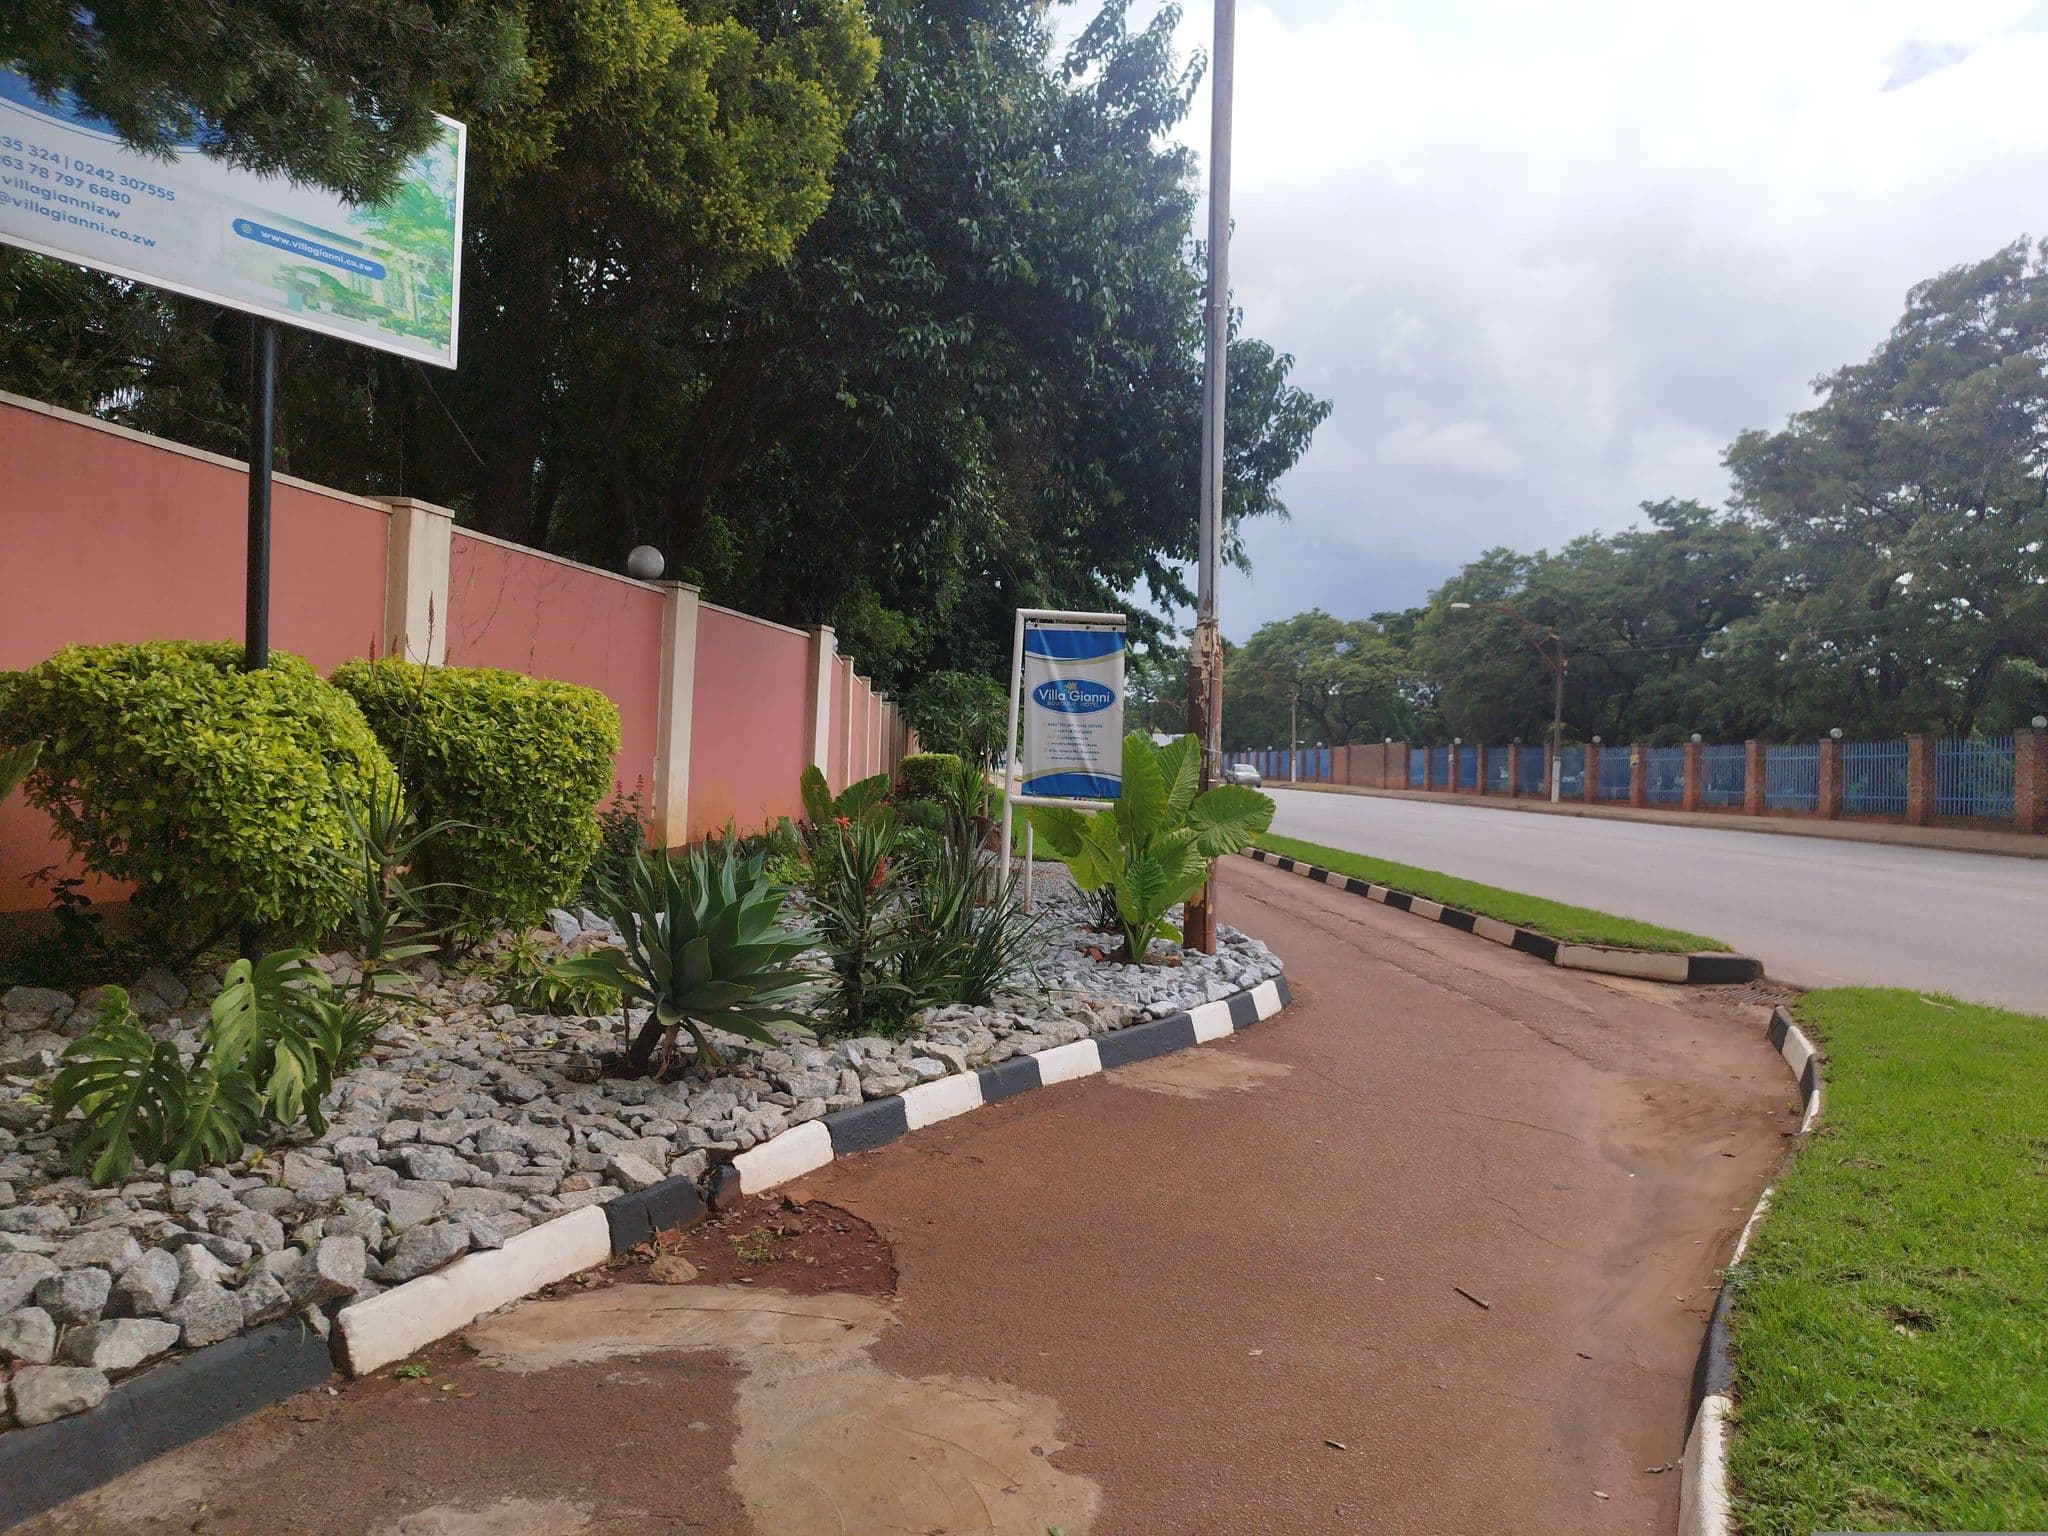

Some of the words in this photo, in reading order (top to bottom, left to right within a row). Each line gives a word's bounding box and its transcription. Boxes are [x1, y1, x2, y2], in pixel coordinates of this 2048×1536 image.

[0, 136, 23, 153] 35
[28, 144, 60, 164] 324
[74, 160, 115, 182] 0242
[120, 175, 175, 202] 307555
[0, 155, 24, 172] 63
[29, 163, 49, 179] 78
[55, 171, 85, 189] 797
[90, 183, 131, 205] 6880
[2, 176, 120, 219] villagiannizw
[260, 230, 373, 272] www.villagianni.co.zw
[1038, 689, 1066, 701] Villa
[1069, 690, 1110, 703] Gianni
